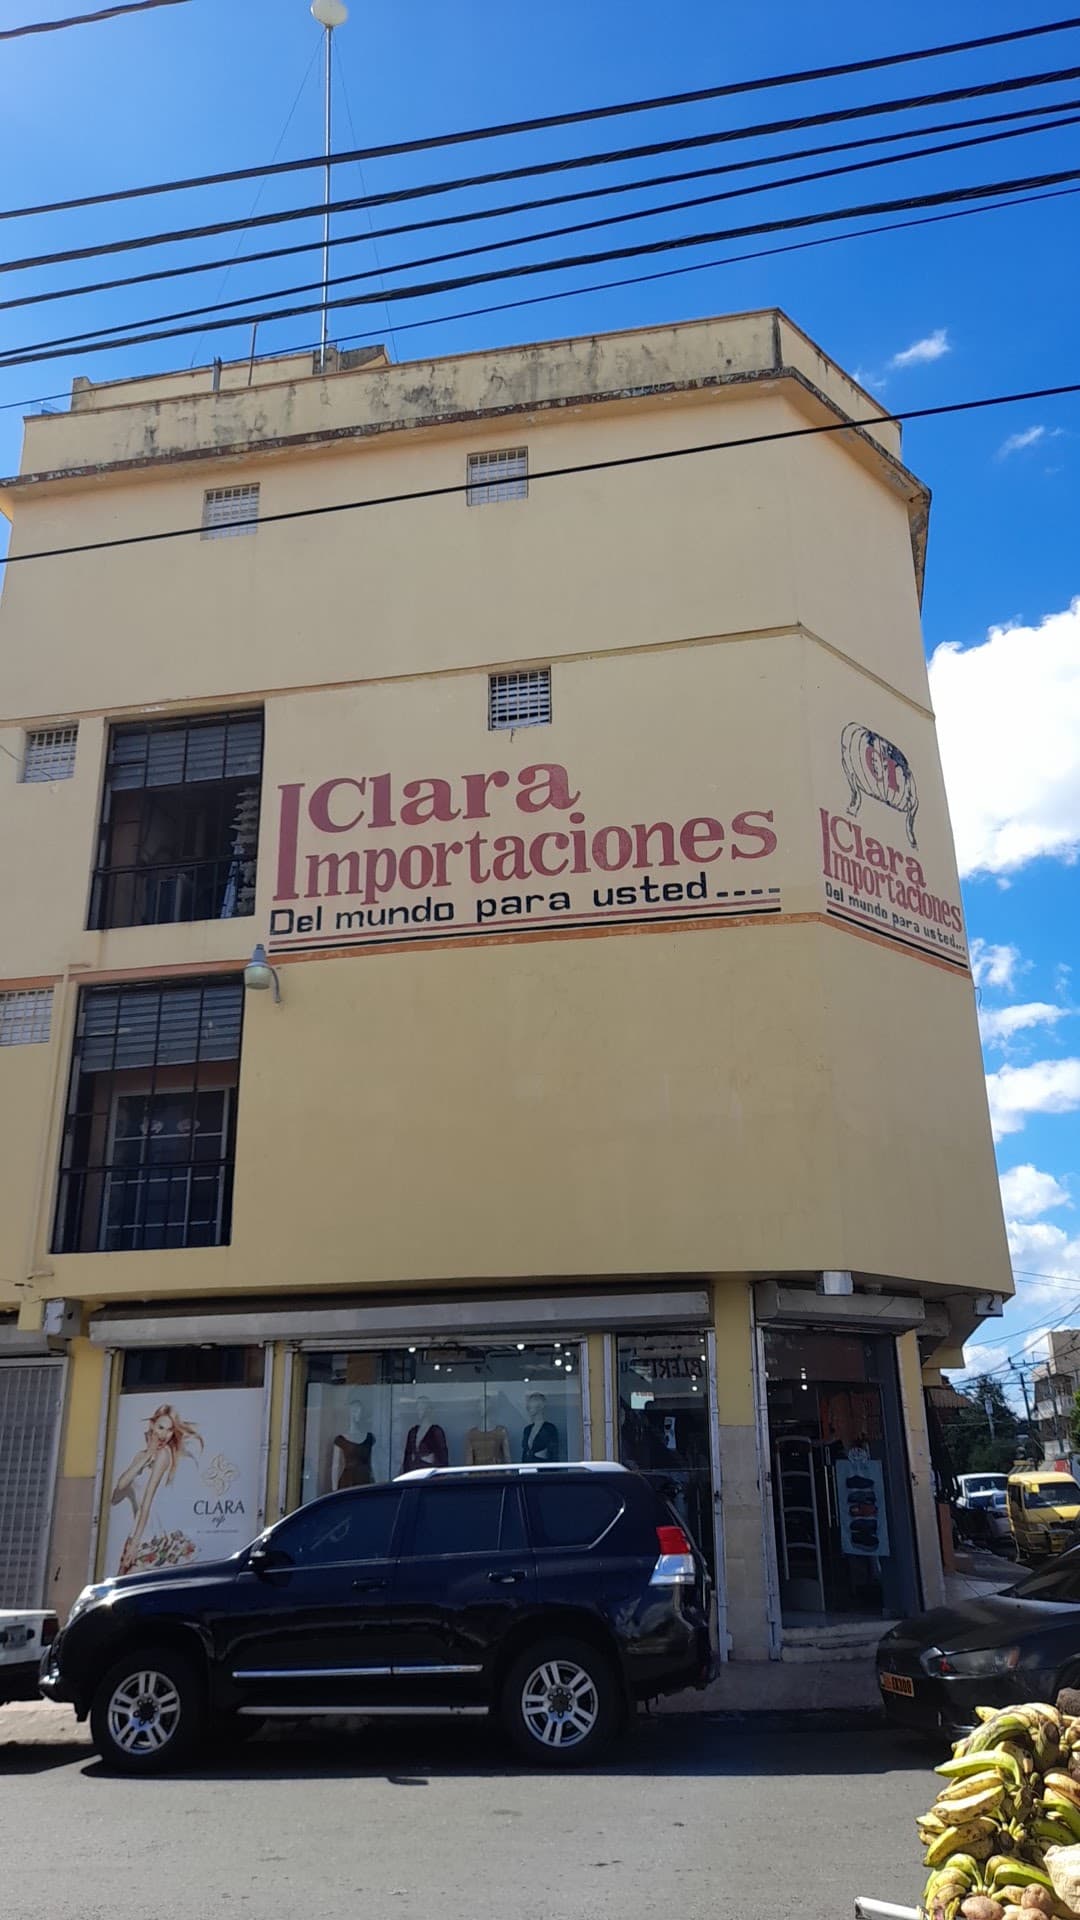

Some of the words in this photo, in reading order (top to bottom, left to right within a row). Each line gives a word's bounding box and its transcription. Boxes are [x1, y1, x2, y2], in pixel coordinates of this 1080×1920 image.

[272, 783, 778, 906] Importaciones
[819, 807, 963, 933] Importaciones
[269, 905, 322, 935] Del
[335, 896, 454, 931] mundo
[476, 890, 571, 923] para
[825, 881, 844, 903] Del
[849, 894, 888, 919] mundo
[892, 912, 920, 933] para
[193, 1500, 245, 1516] CLARA
